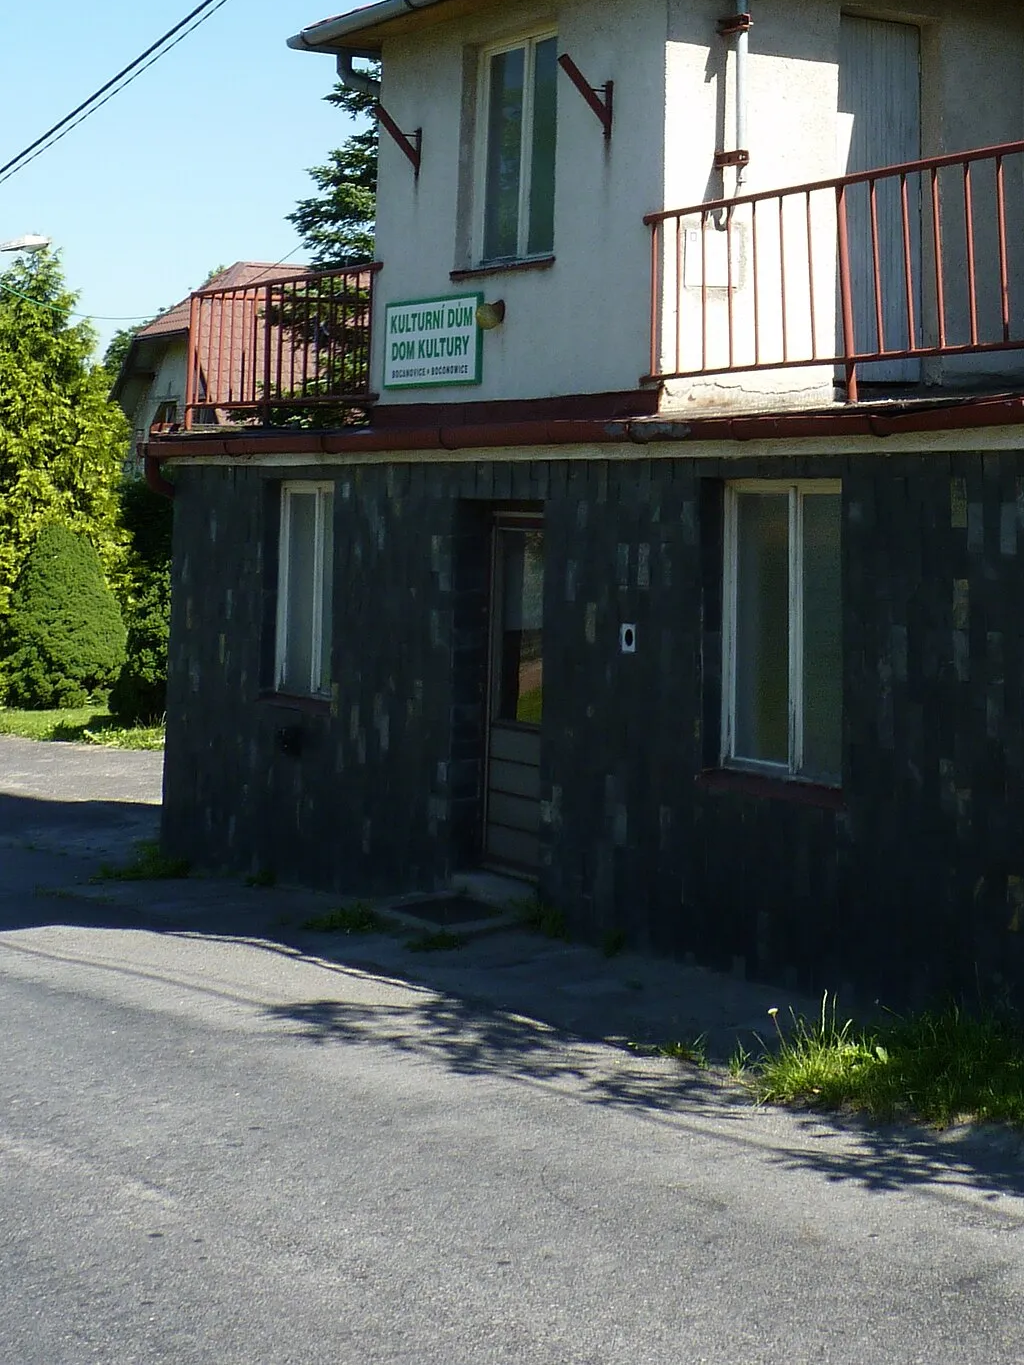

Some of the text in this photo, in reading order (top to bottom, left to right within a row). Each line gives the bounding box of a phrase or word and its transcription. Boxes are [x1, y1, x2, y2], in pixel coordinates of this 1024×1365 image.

[391, 302, 472, 333] KULTURNÍ DŮM
[392, 335, 469, 361] DOM KULTURY
